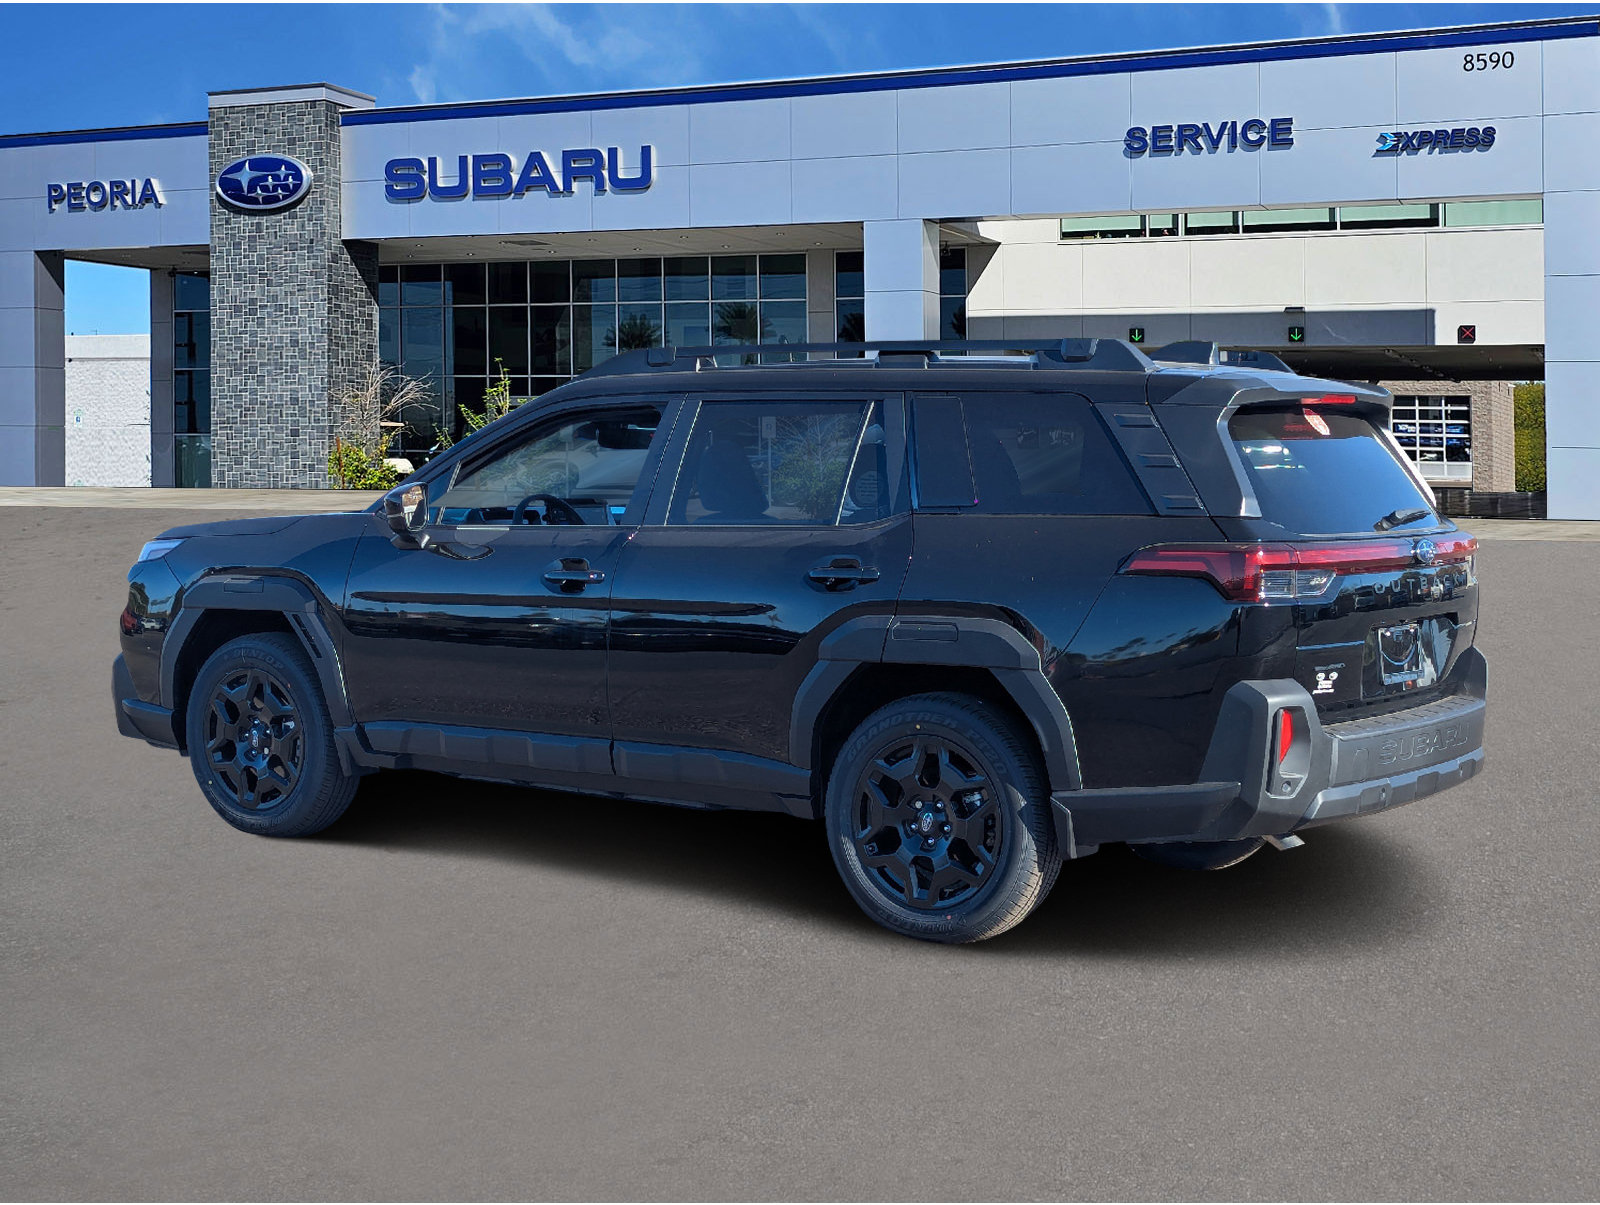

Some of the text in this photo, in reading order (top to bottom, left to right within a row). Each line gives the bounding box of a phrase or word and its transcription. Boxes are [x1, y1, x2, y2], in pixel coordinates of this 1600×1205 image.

[1463, 51, 1515, 72] 8590
[1124, 117, 1294, 153] SERVICE
[1375, 126, 1497, 152] EXPRESS
[384, 145, 653, 201] SUBARU
[47, 178, 161, 212] PEORIA
[1374, 573, 1463, 594] OUTBACK
[1379, 722, 1470, 765] SUBARU
